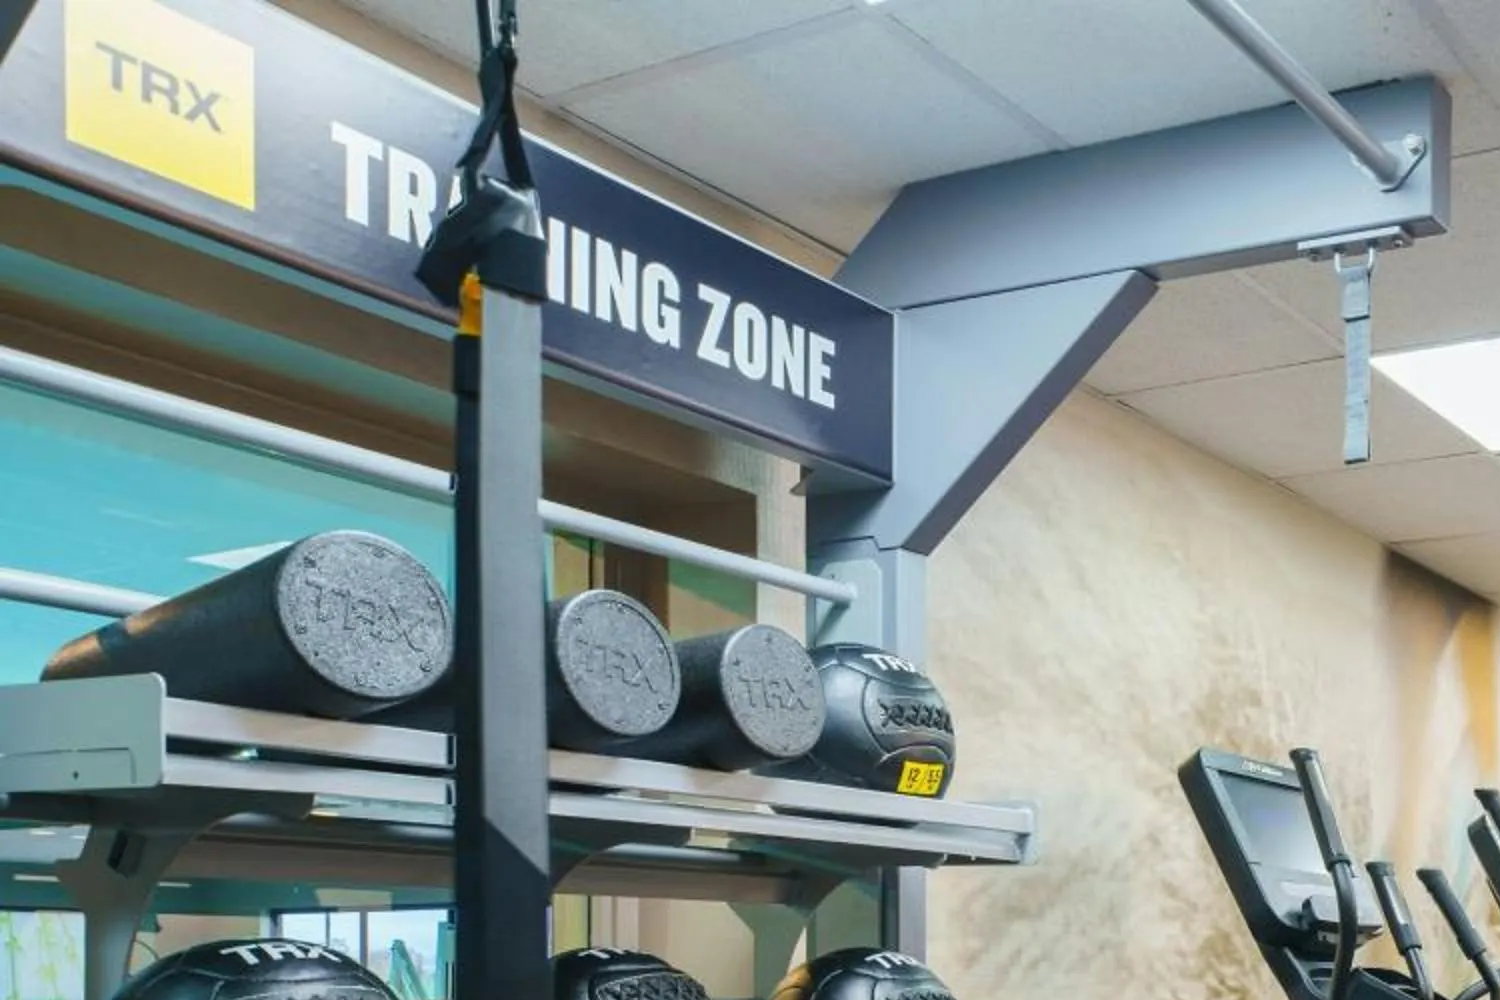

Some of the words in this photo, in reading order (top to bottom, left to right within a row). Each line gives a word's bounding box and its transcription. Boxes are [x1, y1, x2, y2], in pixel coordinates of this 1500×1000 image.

[95, 41, 222, 134] TRX
[331, 121, 681, 350] TRING
[697, 283, 836, 410] ZONE
[304, 573, 425, 653] TRX
[575, 638, 659, 695] TRX
[738, 675, 811, 711] TRX
[219, 943, 342, 965] TRX
